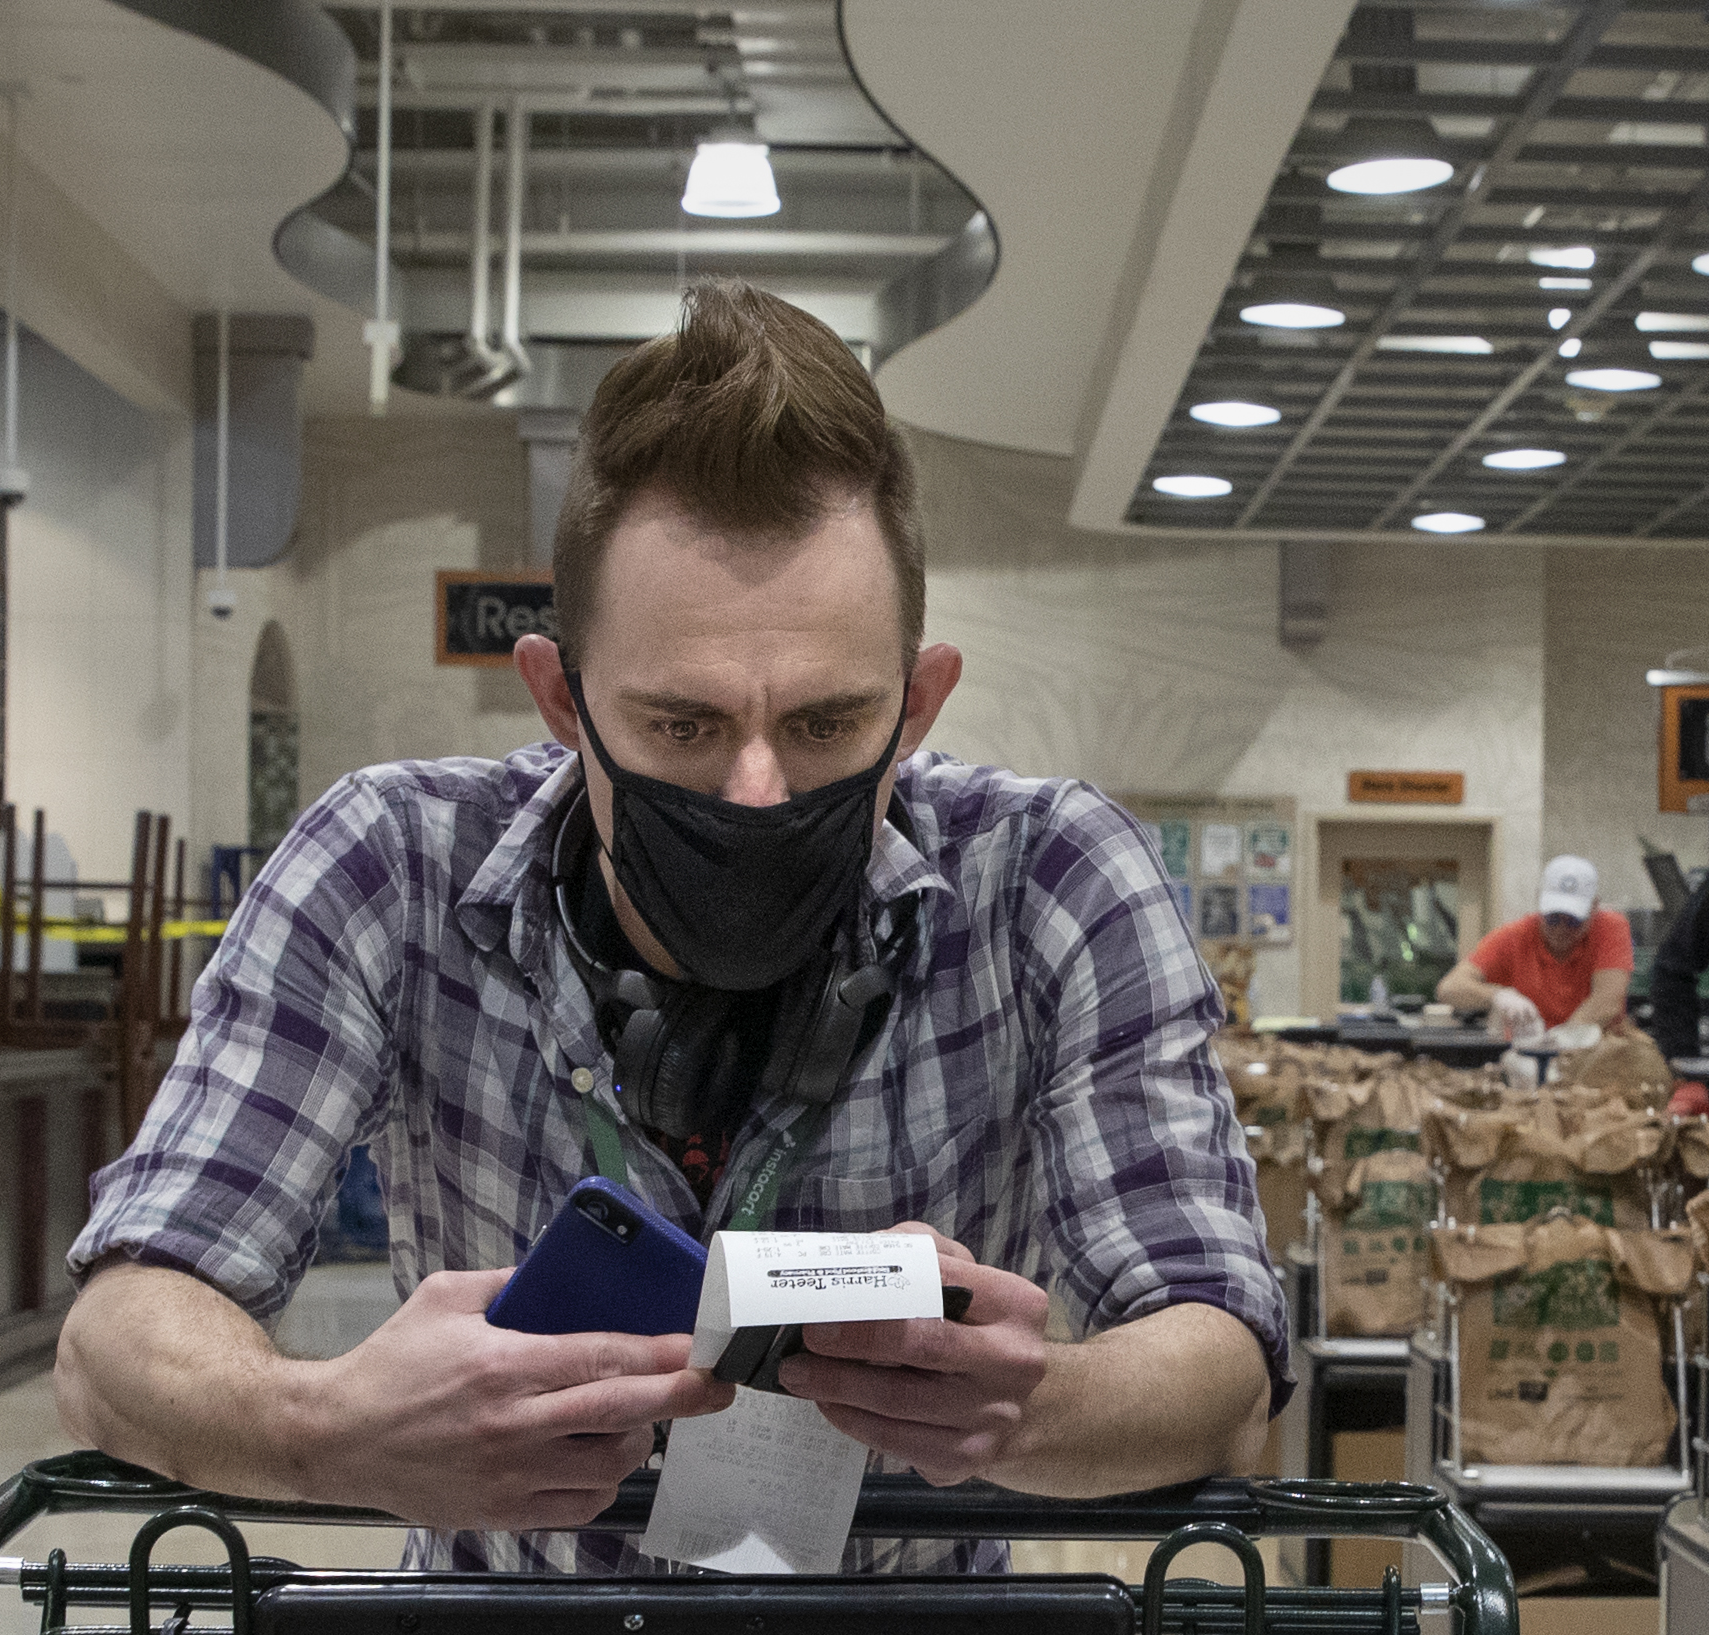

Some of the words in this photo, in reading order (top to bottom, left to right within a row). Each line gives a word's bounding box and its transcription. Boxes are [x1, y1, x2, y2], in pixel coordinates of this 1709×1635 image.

[741, 1148, 787, 1216] instacart
[770, 1277, 827, 1291] Teeter
[831, 1275, 888, 1289] Harris
